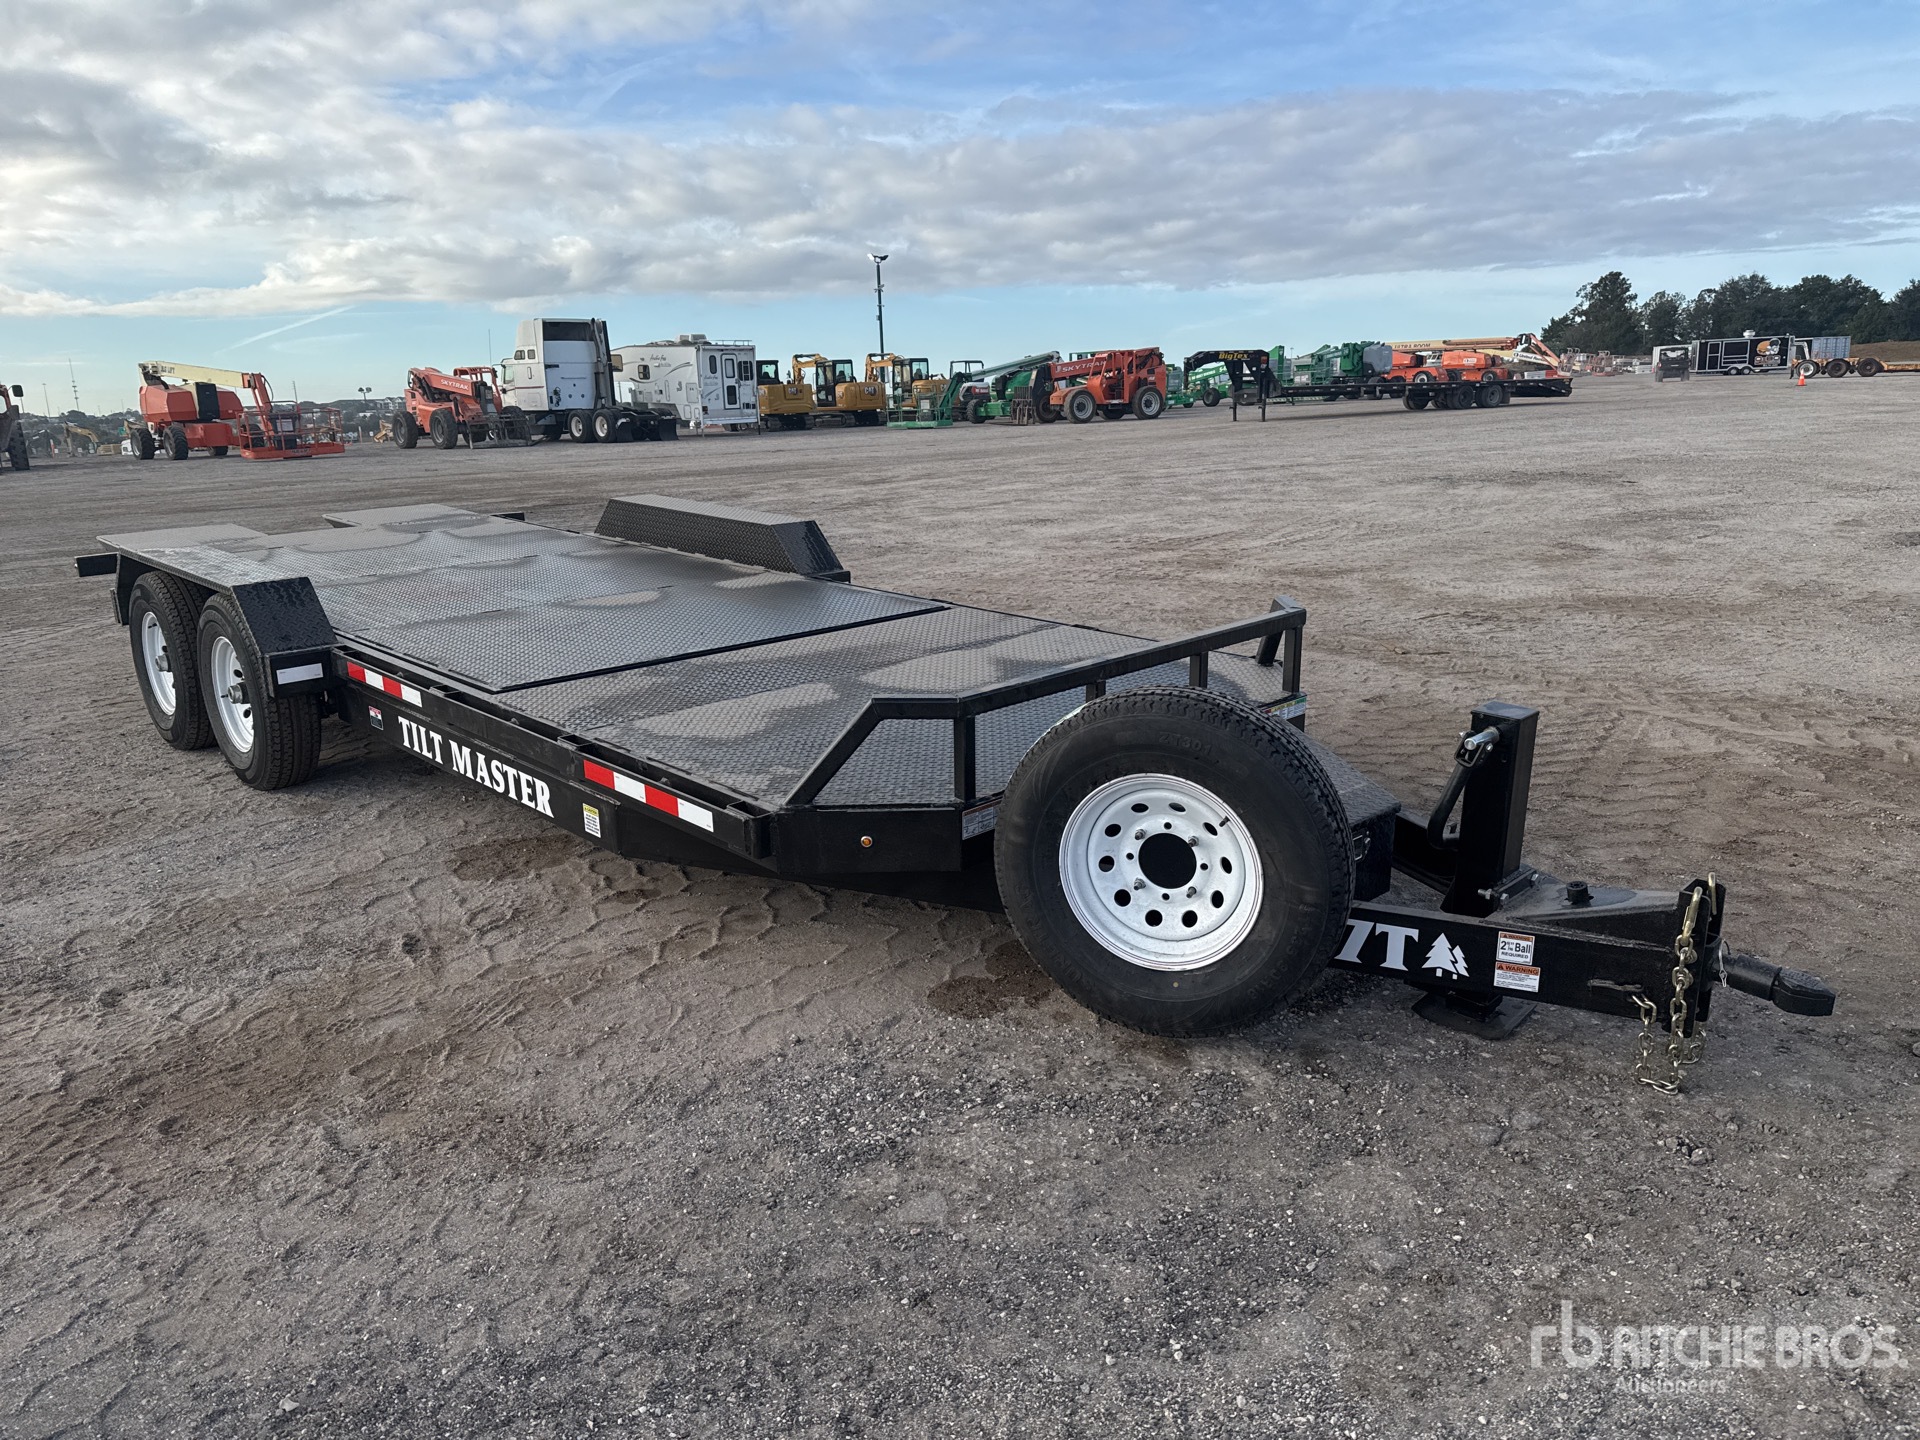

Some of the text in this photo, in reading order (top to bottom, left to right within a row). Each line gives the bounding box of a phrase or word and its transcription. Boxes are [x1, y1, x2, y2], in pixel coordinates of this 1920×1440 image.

[440, 378, 469, 391] SKYTRAK
[397, 715, 555, 818] TILT MASTER
[1514, 943, 1530, 953] Ball
[1501, 951, 1529, 959] REQUIRED
[1505, 965, 1538, 975] WARNING
